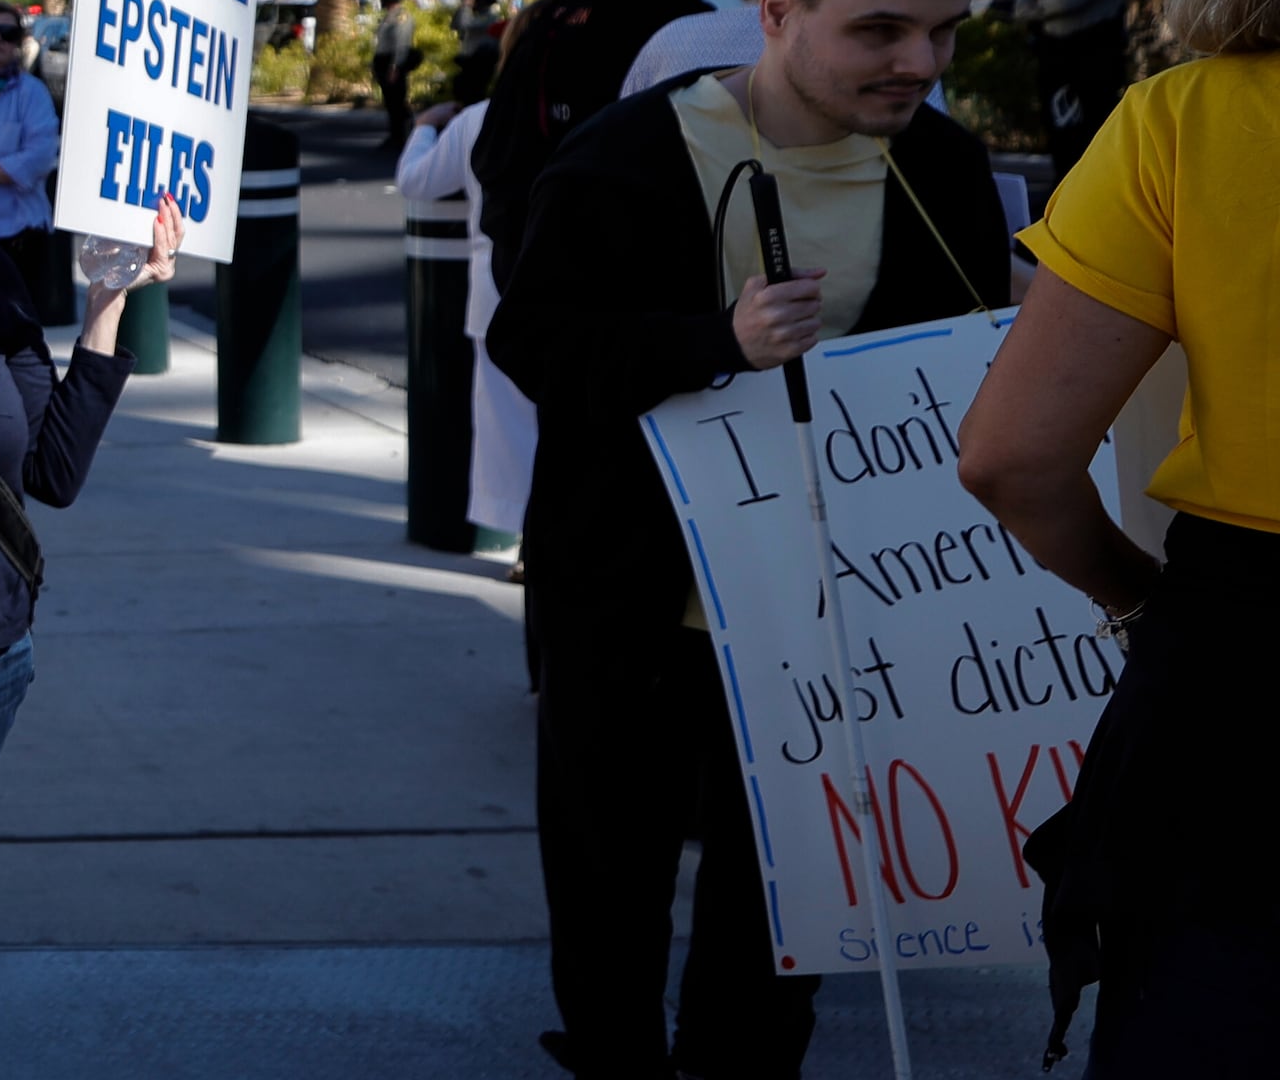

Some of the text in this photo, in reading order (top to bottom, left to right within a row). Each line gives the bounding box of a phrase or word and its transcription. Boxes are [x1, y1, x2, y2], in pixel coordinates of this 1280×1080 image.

[100, 109, 213, 223] FILES
[697, 366, 959, 506] I don't
[817, 521, 1040, 618] Ameri
[781, 636, 904, 764] just
[950, 606, 1128, 715] dicta
[820, 758, 960, 907] NO
[839, 920, 990, 962] Sience
